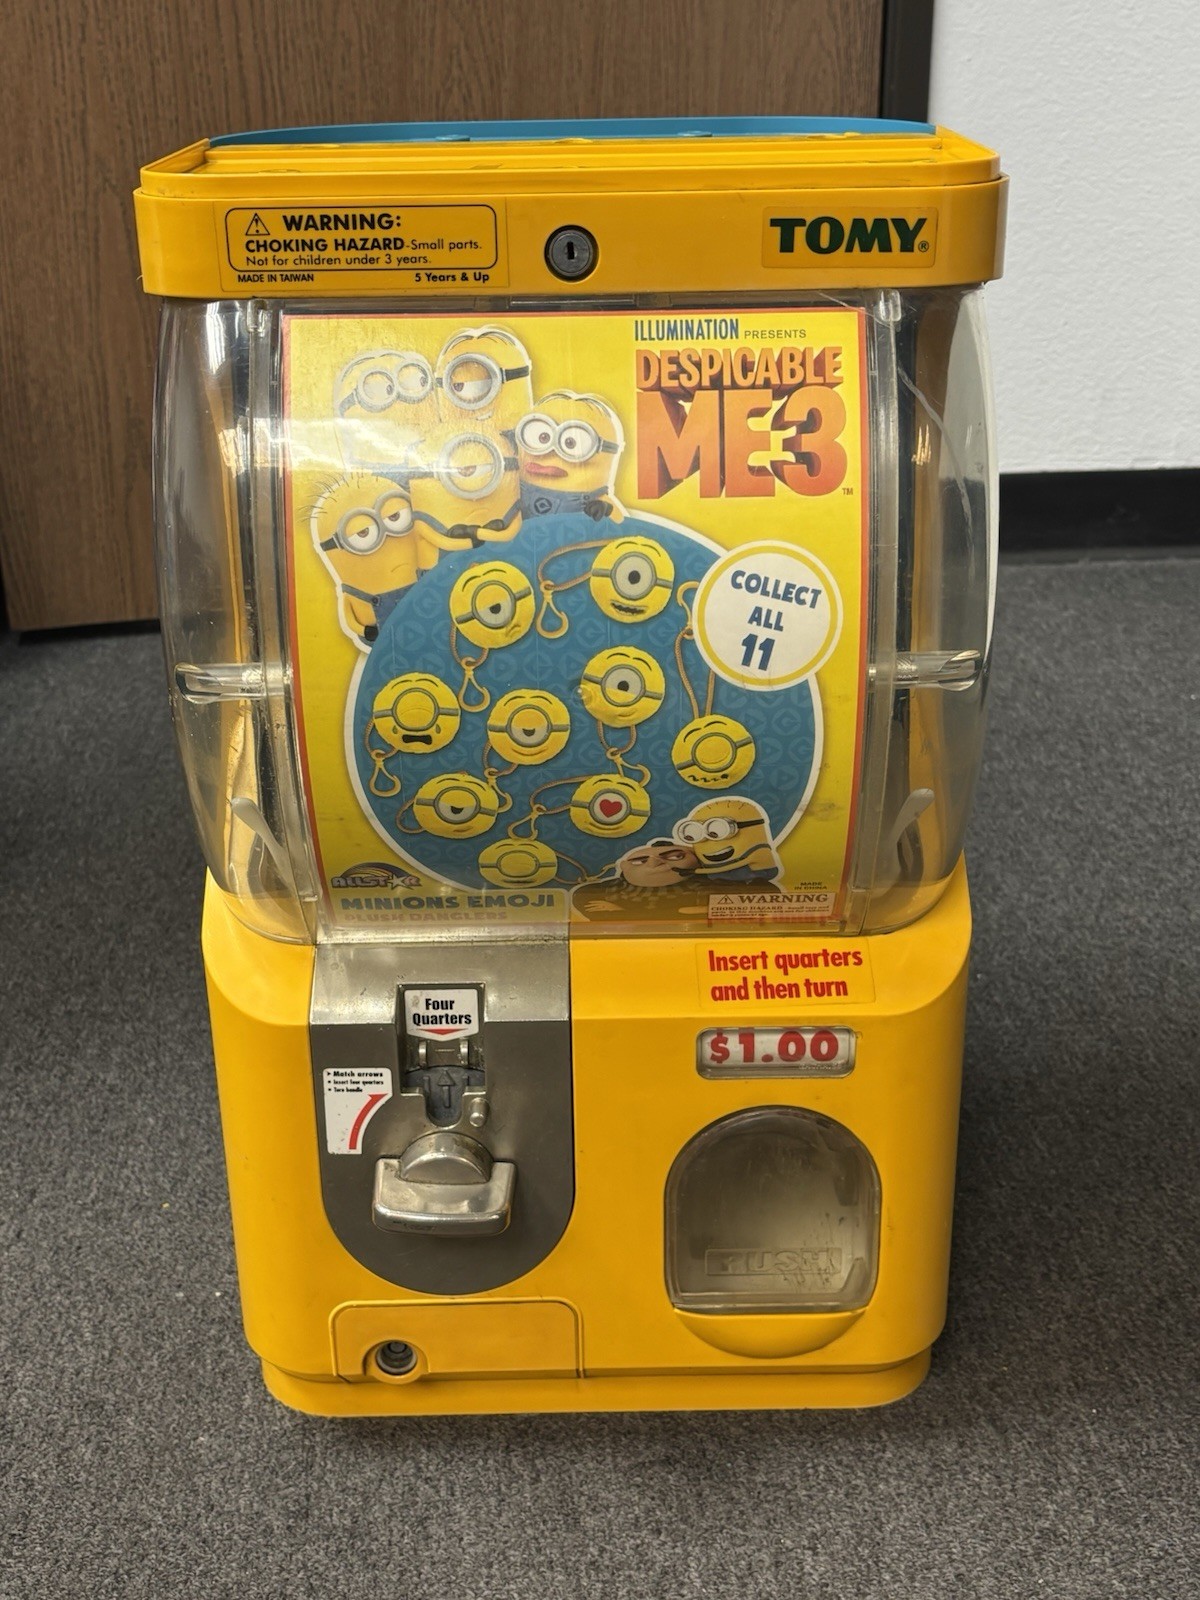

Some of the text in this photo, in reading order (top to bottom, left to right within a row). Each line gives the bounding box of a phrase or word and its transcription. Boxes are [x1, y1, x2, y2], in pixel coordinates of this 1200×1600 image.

[282, 212, 402, 232] WARNING:
[244, 238, 328, 253] CHOKING
[448, 239, 483, 253] parts.
[245, 253, 432, 267] Not for children under 3 years.
[237, 273, 314, 283] MADE IN TAIWAN
[414, 272, 490, 284] 5 Years & Up
[634, 318, 807, 341] ILLUMINATION PRESENTS
[635, 346, 844, 391] DESPICABLE
[730, 569, 822, 609] COLLECT
[747, 606, 784, 632] ALL
[741, 633, 775, 672] 11
[340, 894, 555, 911] MINIONS EMOJI
[738, 893, 829, 904] WARNING
[409, 911, 508, 922] DANGLERS
[708, 948, 863, 976] Insert quarters
[710, 975, 849, 1002] and then turn
[425, 998, 455, 1010] Four
[412, 1013, 472, 1026] Quarters
[709, 1028, 839, 1064] $1.00
